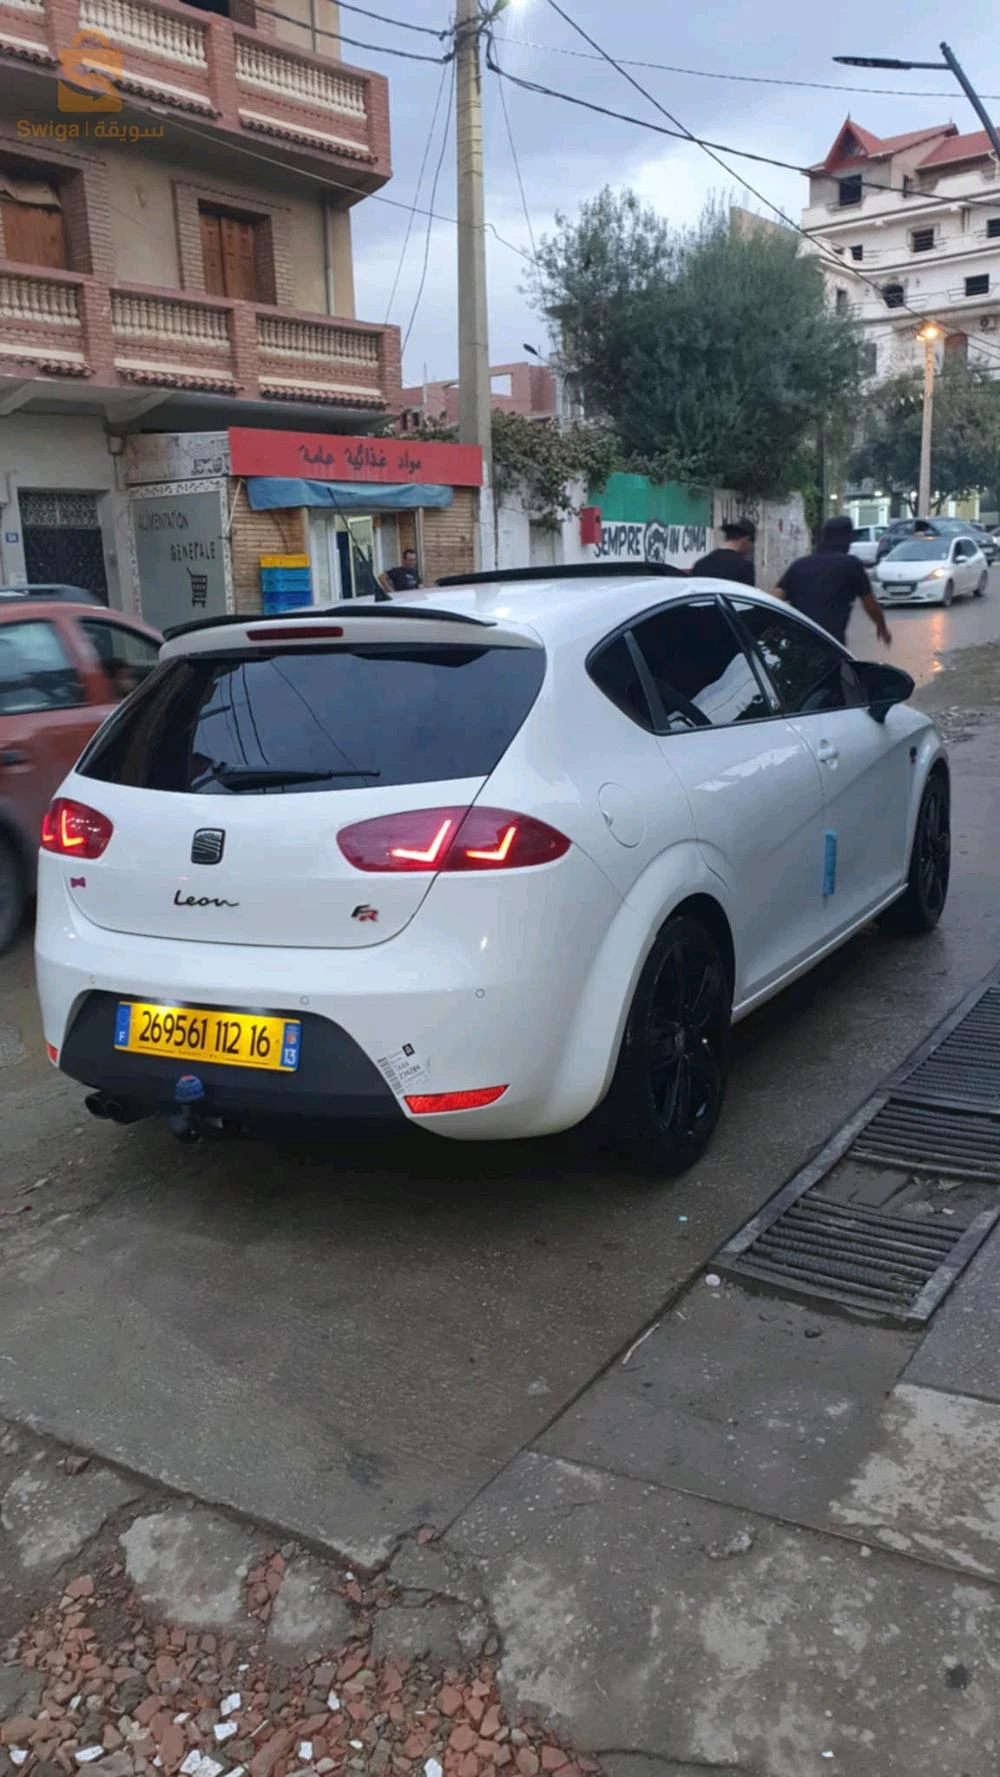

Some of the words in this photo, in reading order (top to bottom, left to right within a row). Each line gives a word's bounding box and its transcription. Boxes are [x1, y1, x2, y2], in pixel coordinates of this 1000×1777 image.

[397, 449, 422, 475] مواد
[669, 527, 680, 554] IN
[174, 889, 239, 907] Leon
[351, 904, 379, 922] FR
[138, 1010, 208, 1050] 269561
[215, 1019, 242, 1055] 112
[249, 1024, 271, 1058] 16
[283, 1047, 297, 1065] 13
